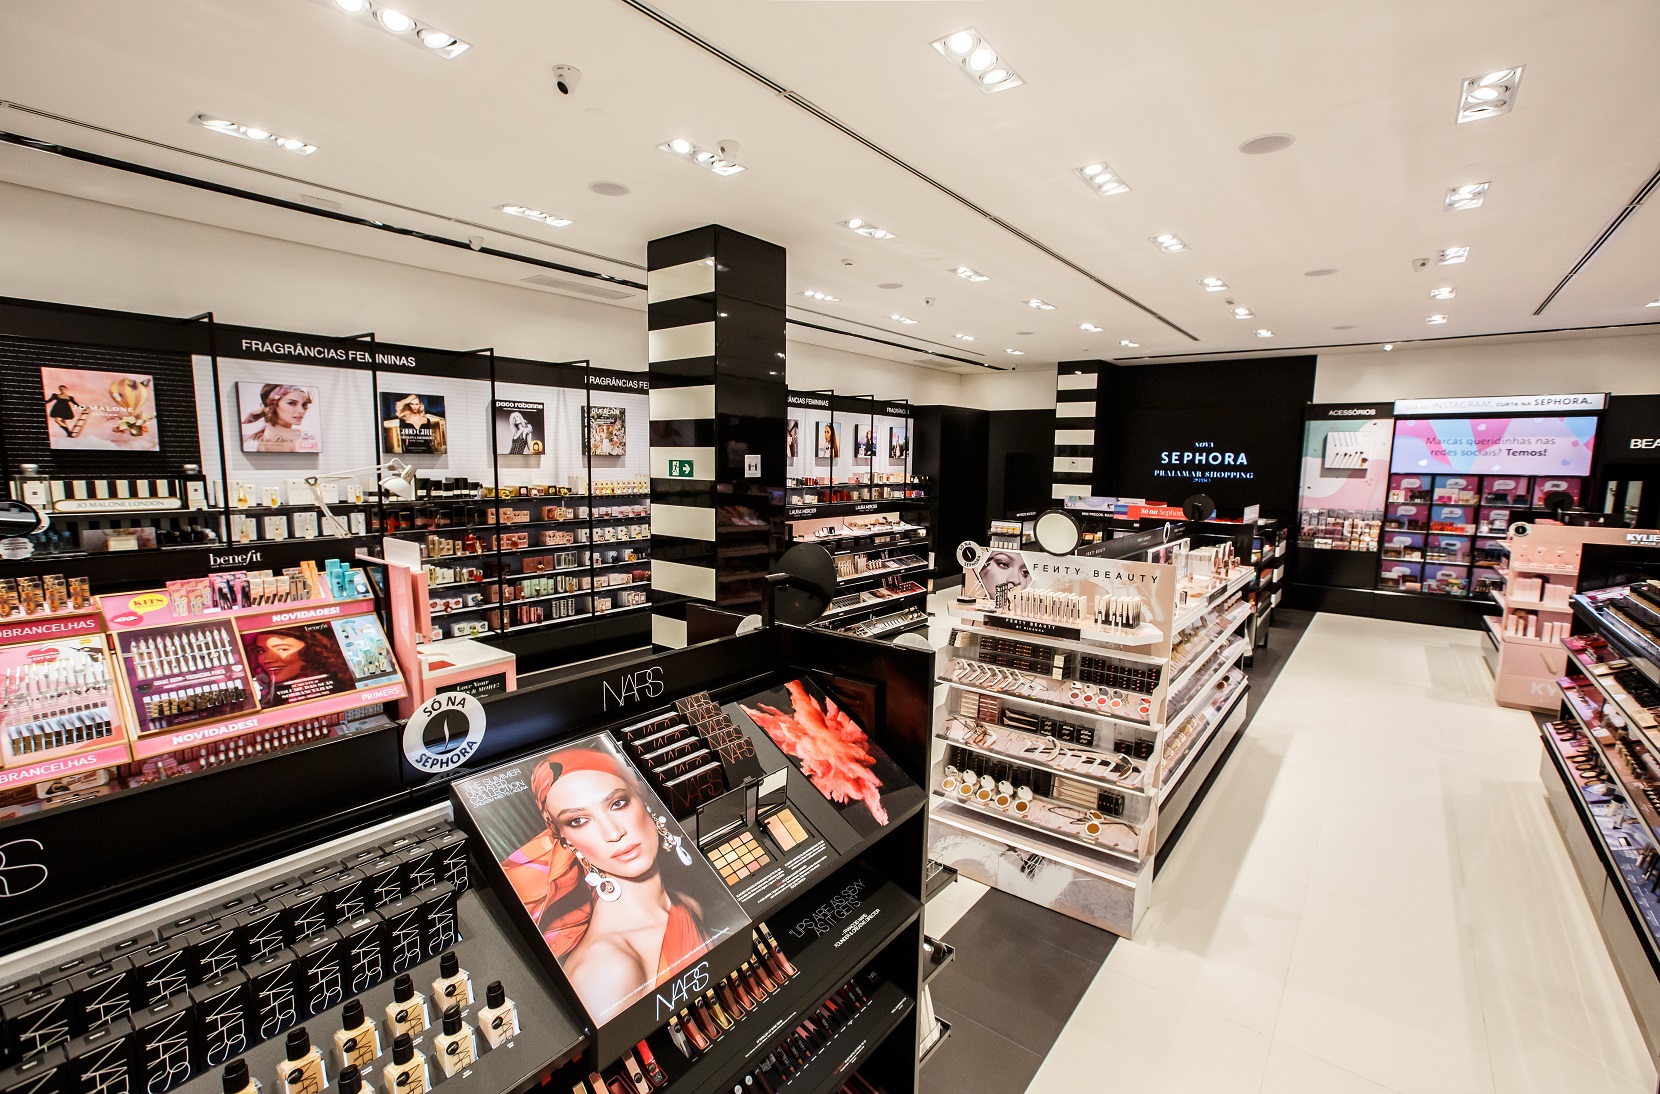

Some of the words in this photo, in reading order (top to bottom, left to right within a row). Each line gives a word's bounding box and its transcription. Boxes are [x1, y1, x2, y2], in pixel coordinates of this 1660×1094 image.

[241, 339, 346, 360] FRAGRÂNCIAS
[89, 405, 134, 413] MALONE
[1425, 437, 1464, 445] Marcas
[1466, 437, 1532, 447] queridinhas
[1430, 448, 1457, 456] redes
[1460, 448, 1502, 456] sociais?
[1505, 448, 1547, 457] Temos!
[1161, 451, 1248, 465] SEPHORA
[1154, 469, 1202, 478] PRAIAMAR
[1205, 471, 1254, 479] SHOPPING
[1626, 533, 1660, 541] KYLIE
[209, 550, 263, 566] benefit
[1093, 570, 1158, 583] BEAUTY
[133, 598, 164, 607] KITS
[272, 606, 340, 622] NOVIDADES!
[361, 686, 400, 701] PRIMERS
[478, 682, 500, 692] MORE!
[603, 666, 665, 711] NARS
[423, 697, 442, 717] SÓ
[446, 696, 466, 708] NA
[172, 719, 258, 745] NOVIDADES!
[416, 741, 477, 768] SEPHORA
[464, 781, 480, 791] THE
[470, 780, 525, 804] COLLECTION
[812, 904, 834, 923] ARE
[830, 895, 845, 909] AS
[841, 879, 865, 899] SEXY
[427, 893, 455, 955] NARS
[814, 922, 830, 937] AS
[825, 913, 837, 926] IT
[392, 908, 421, 973] NARS
[350, 925, 383, 993] NARS
[306, 943, 343, 1015] NARS
[258, 963, 297, 1040] NARS
[656, 961, 709, 1021] NARS
[204, 985, 247, 1067] NARS
[145, 1011, 191, 1094] NARS
